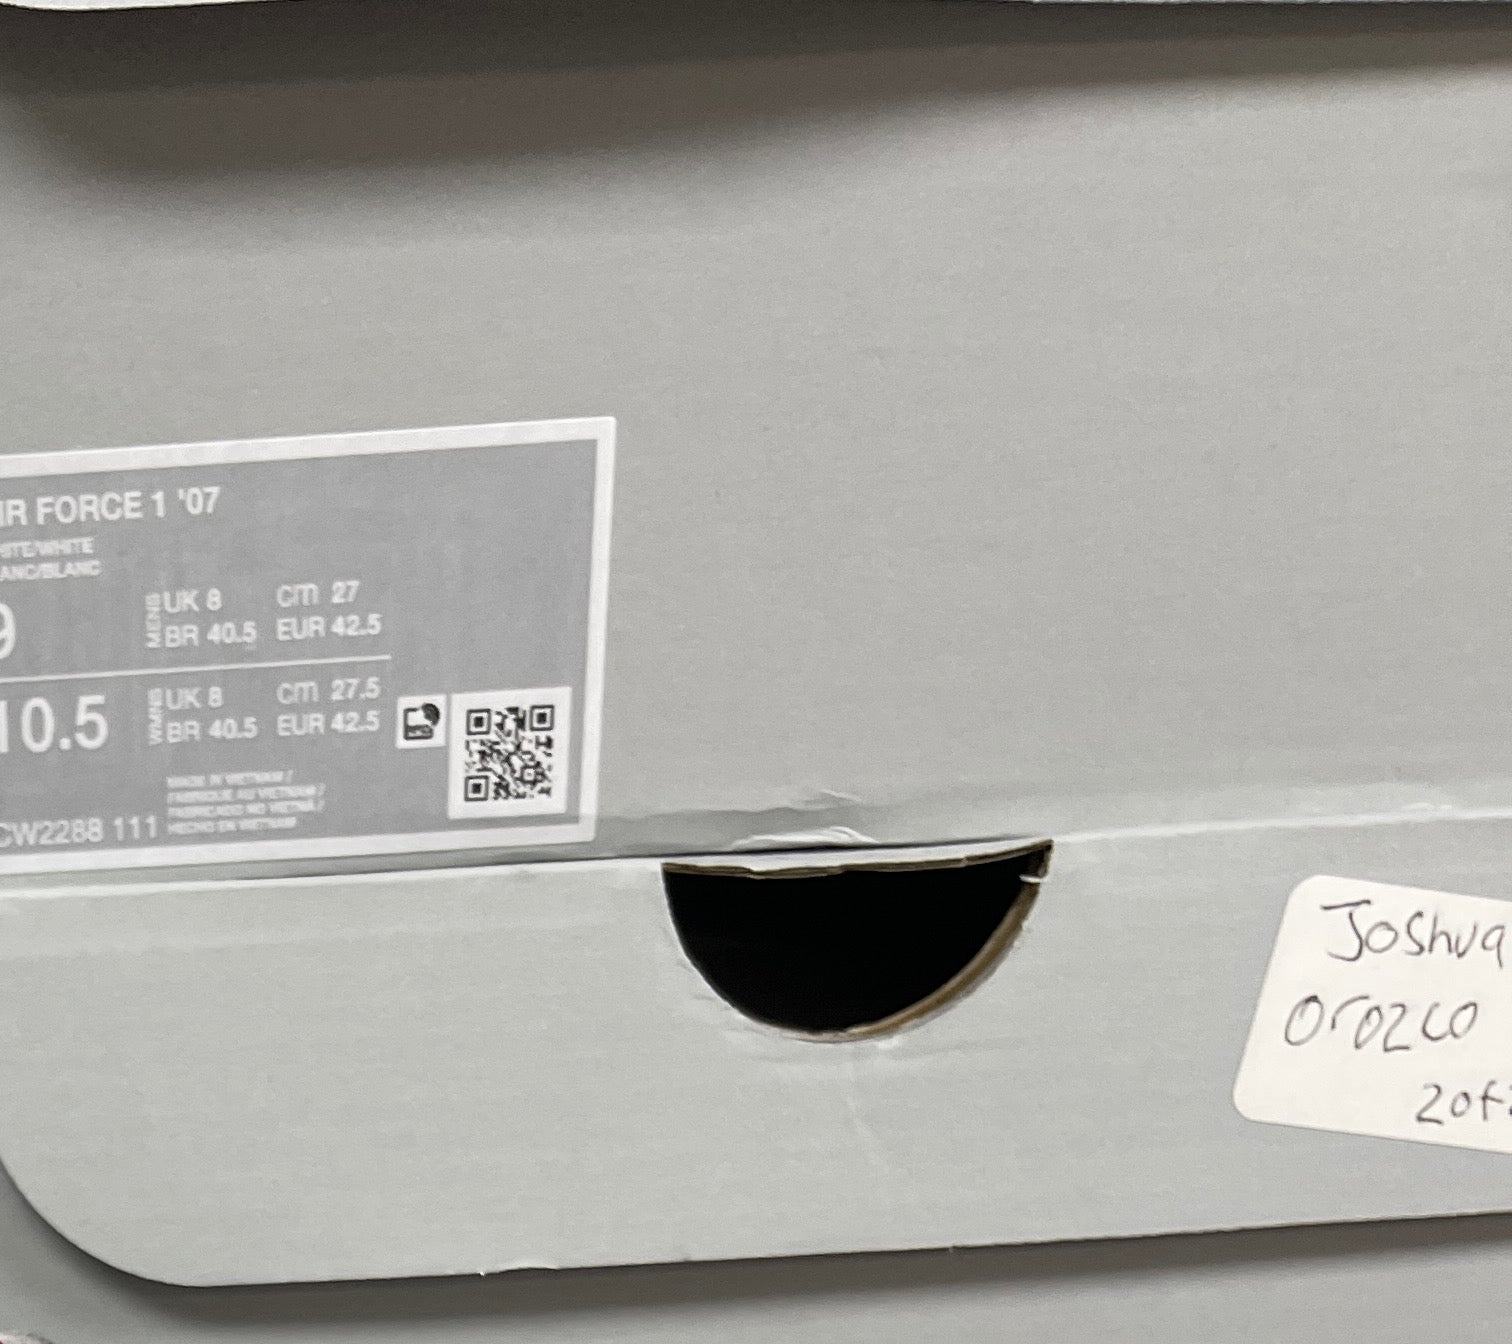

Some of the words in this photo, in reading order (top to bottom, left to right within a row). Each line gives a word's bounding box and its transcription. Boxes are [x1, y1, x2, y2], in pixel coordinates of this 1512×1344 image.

[37, 491, 144, 525] FORCE
[150, 491, 167, 518] 1
[163, 589, 200, 613] UK
[206, 588, 223, 611] 8
[331, 580, 361, 604] 27
[165, 624, 200, 648] BR
[207, 621, 258, 645] 40.5
[276, 615, 326, 641] EUR
[331, 613, 383, 637] 42.5
[165, 687, 202, 711] UK
[208, 686, 224, 709] 8
[331, 676, 382, 701] 27.5
[166, 720, 201, 744] BR
[208, 716, 259, 740] 40.5
[276, 712, 326, 737] EUR
[331, 710, 382, 734] 42.5
[112, 815, 159, 842] 111
